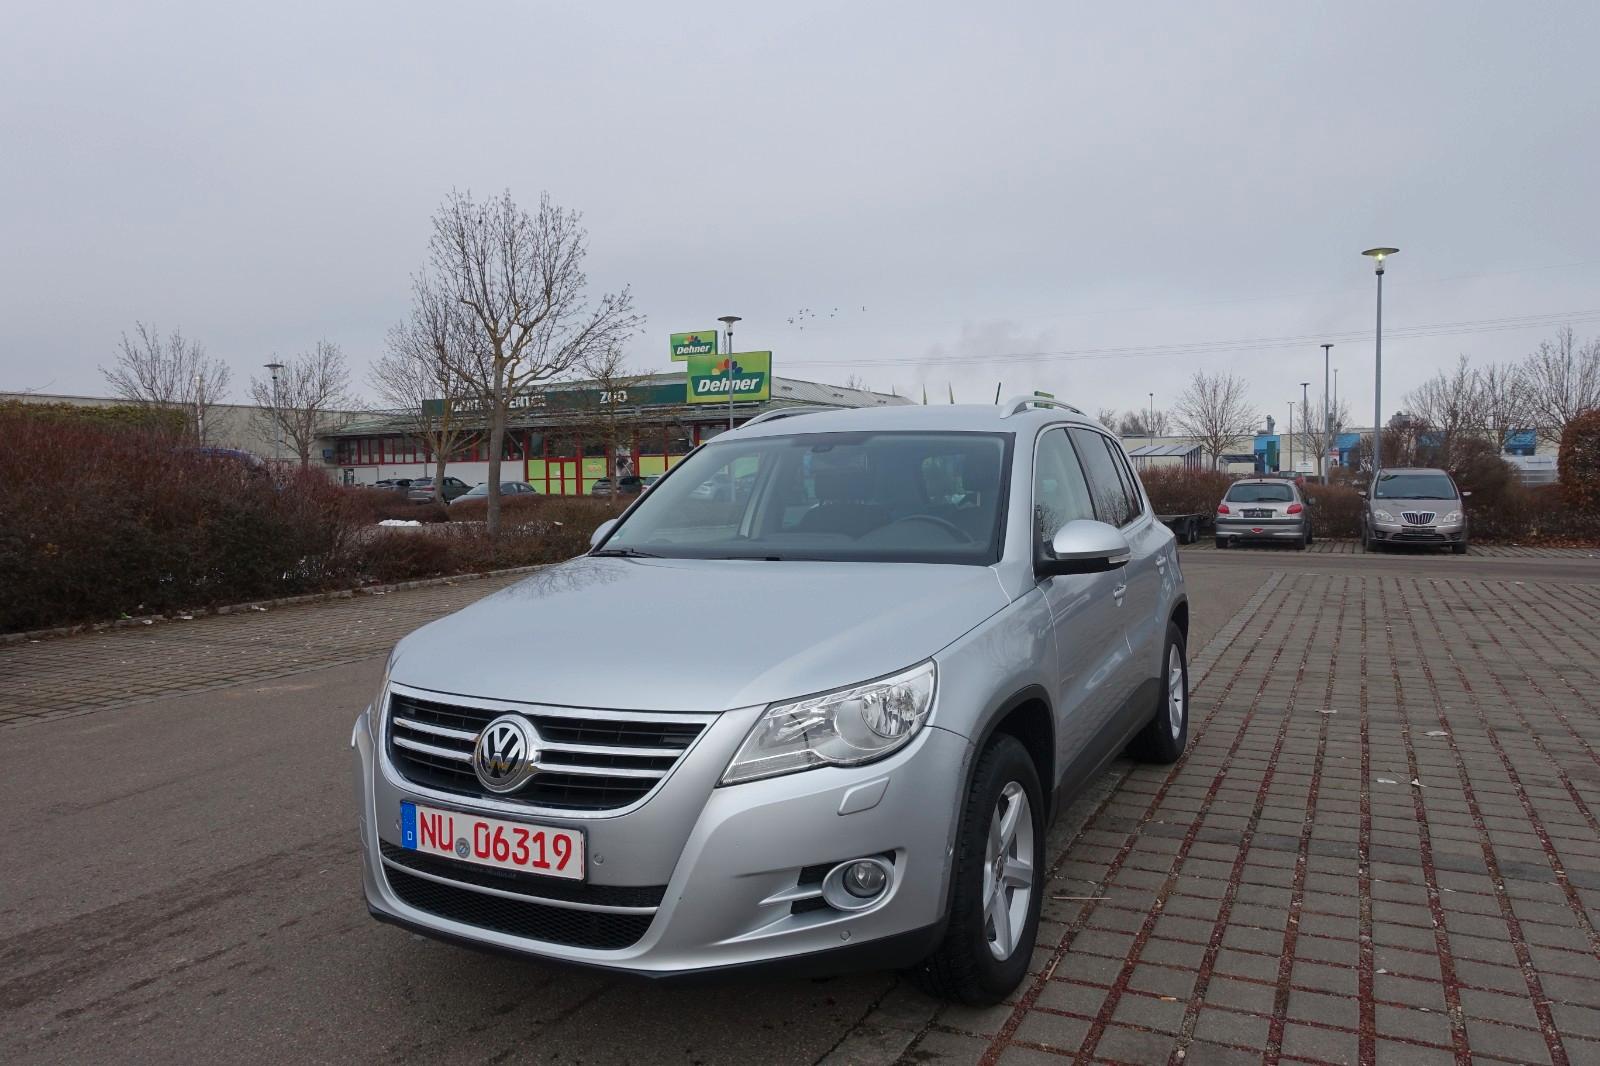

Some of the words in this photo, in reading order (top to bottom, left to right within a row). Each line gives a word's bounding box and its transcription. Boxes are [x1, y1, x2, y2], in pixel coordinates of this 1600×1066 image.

[676, 344, 710, 355] Dehner
[697, 377, 760, 393] Dehner
[407, 830, 413, 841] D
[420, 811, 454, 852] NU
[473, 821, 572, 871] 06319
